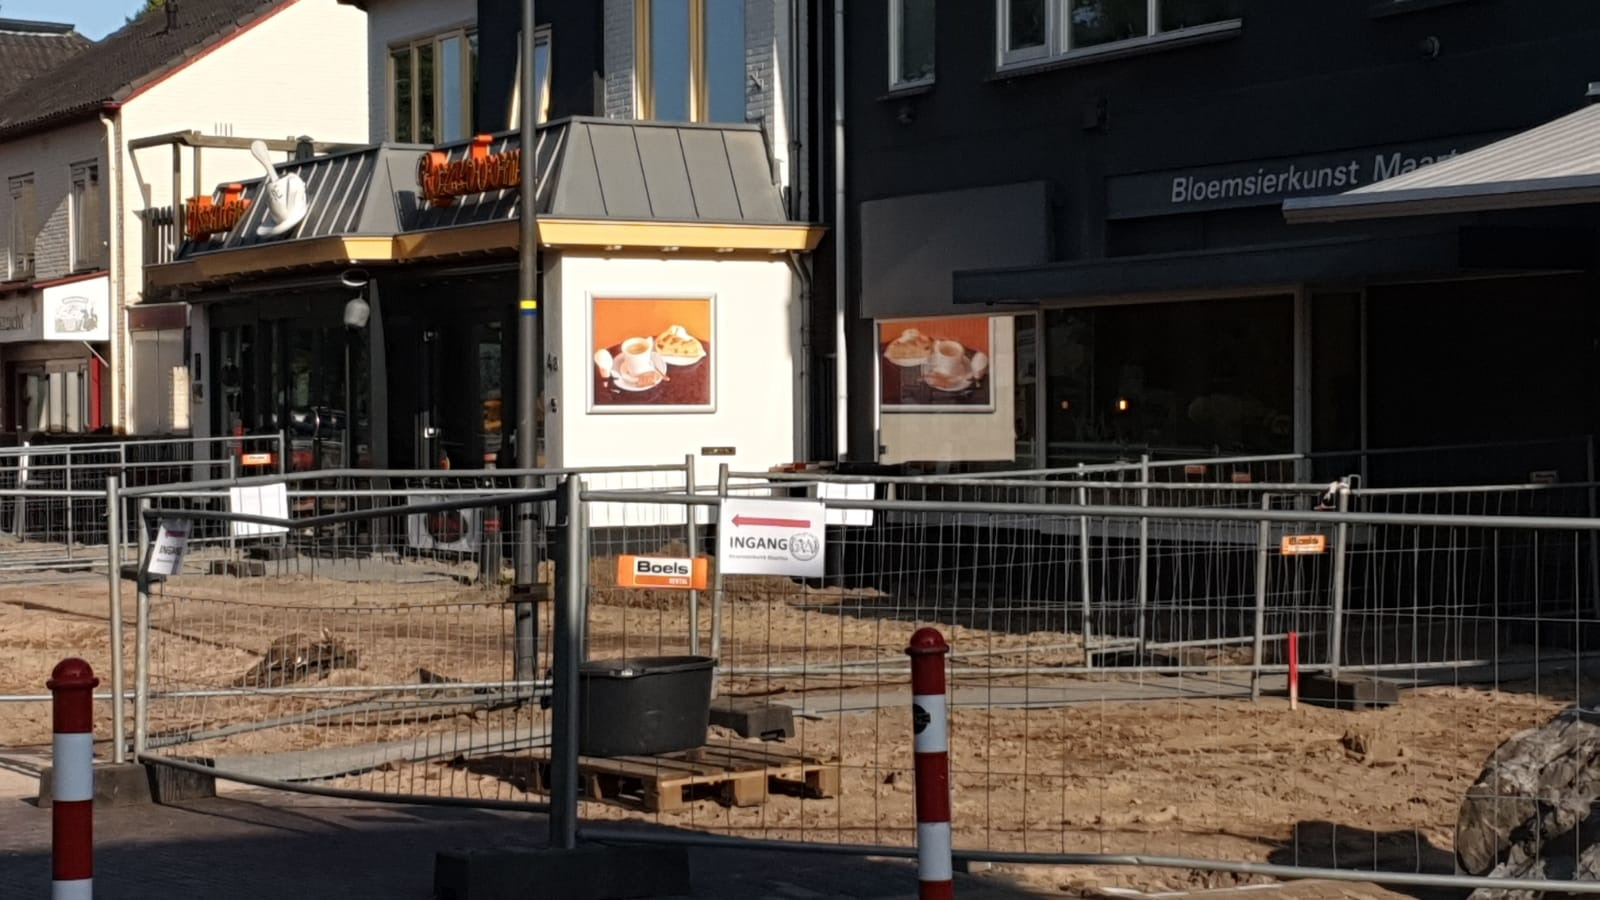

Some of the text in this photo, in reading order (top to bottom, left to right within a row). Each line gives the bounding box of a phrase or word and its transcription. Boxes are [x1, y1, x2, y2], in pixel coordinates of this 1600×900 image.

[1171, 160, 1360, 203] Bloemsierkunst
[729, 536, 788, 551] INGANG
[637, 560, 689, 575] Boels
